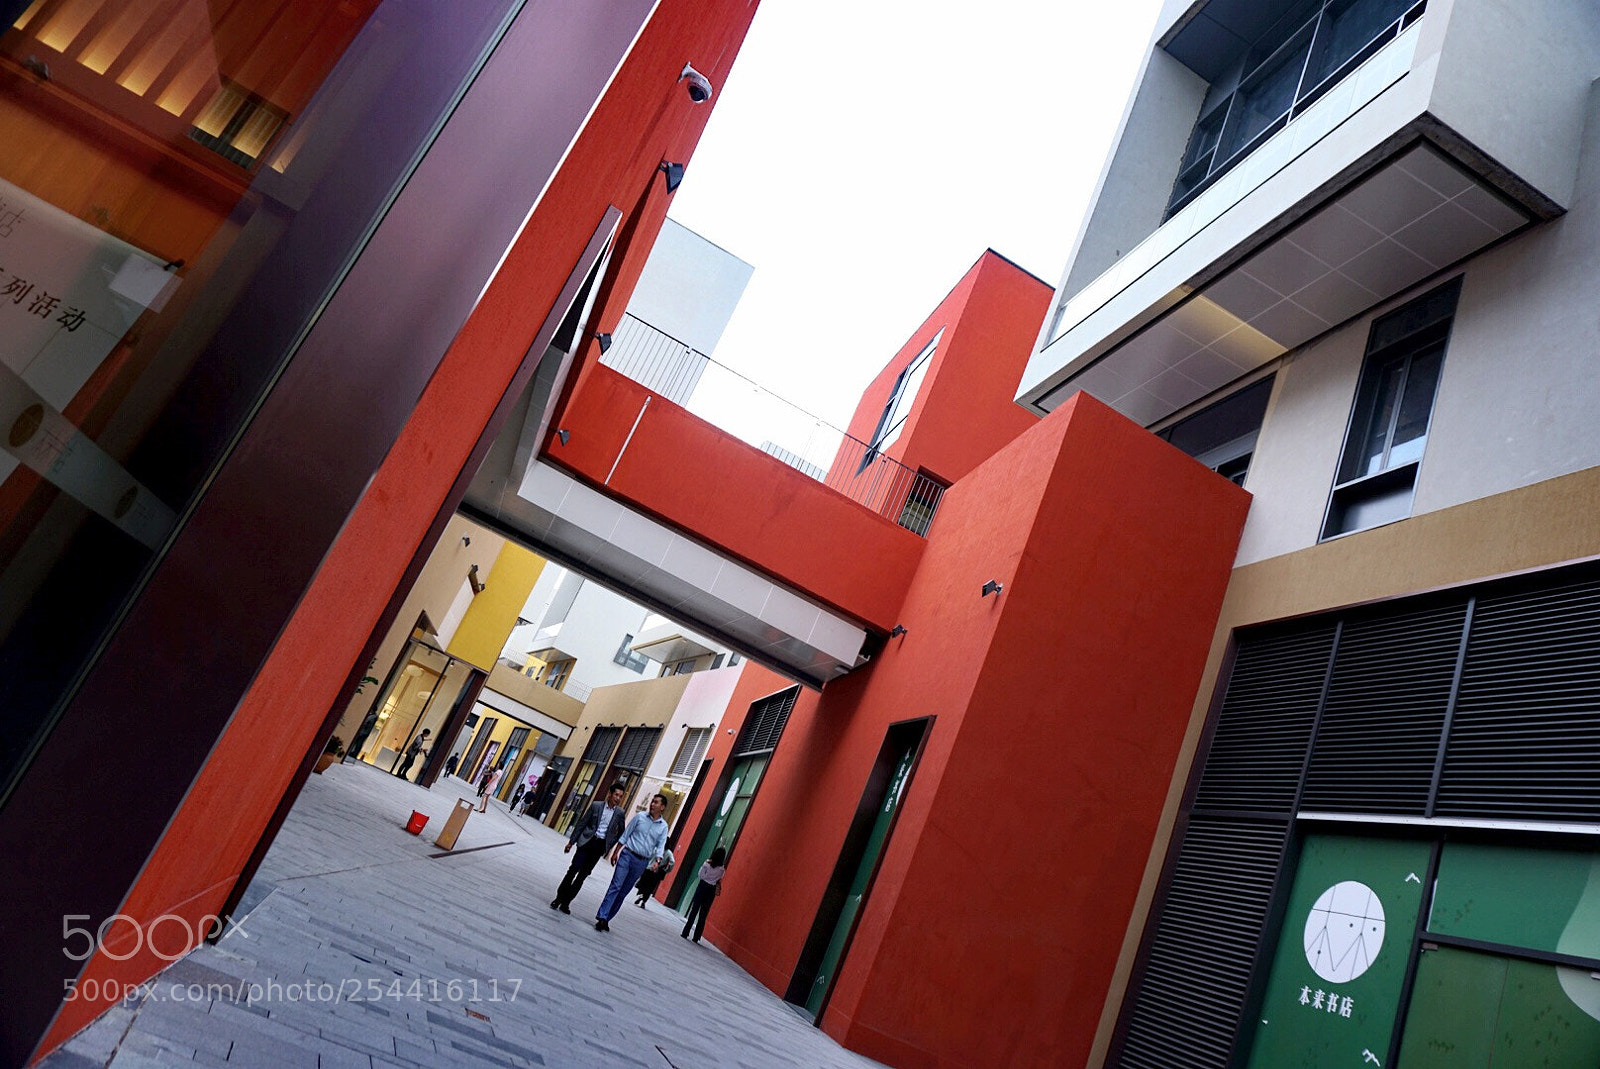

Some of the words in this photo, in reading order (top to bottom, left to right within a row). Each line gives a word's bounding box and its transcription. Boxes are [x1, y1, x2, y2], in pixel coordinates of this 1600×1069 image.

[0, 268, 86, 332] 列活动
[1298, 985, 1354, 1018] 本来书店
